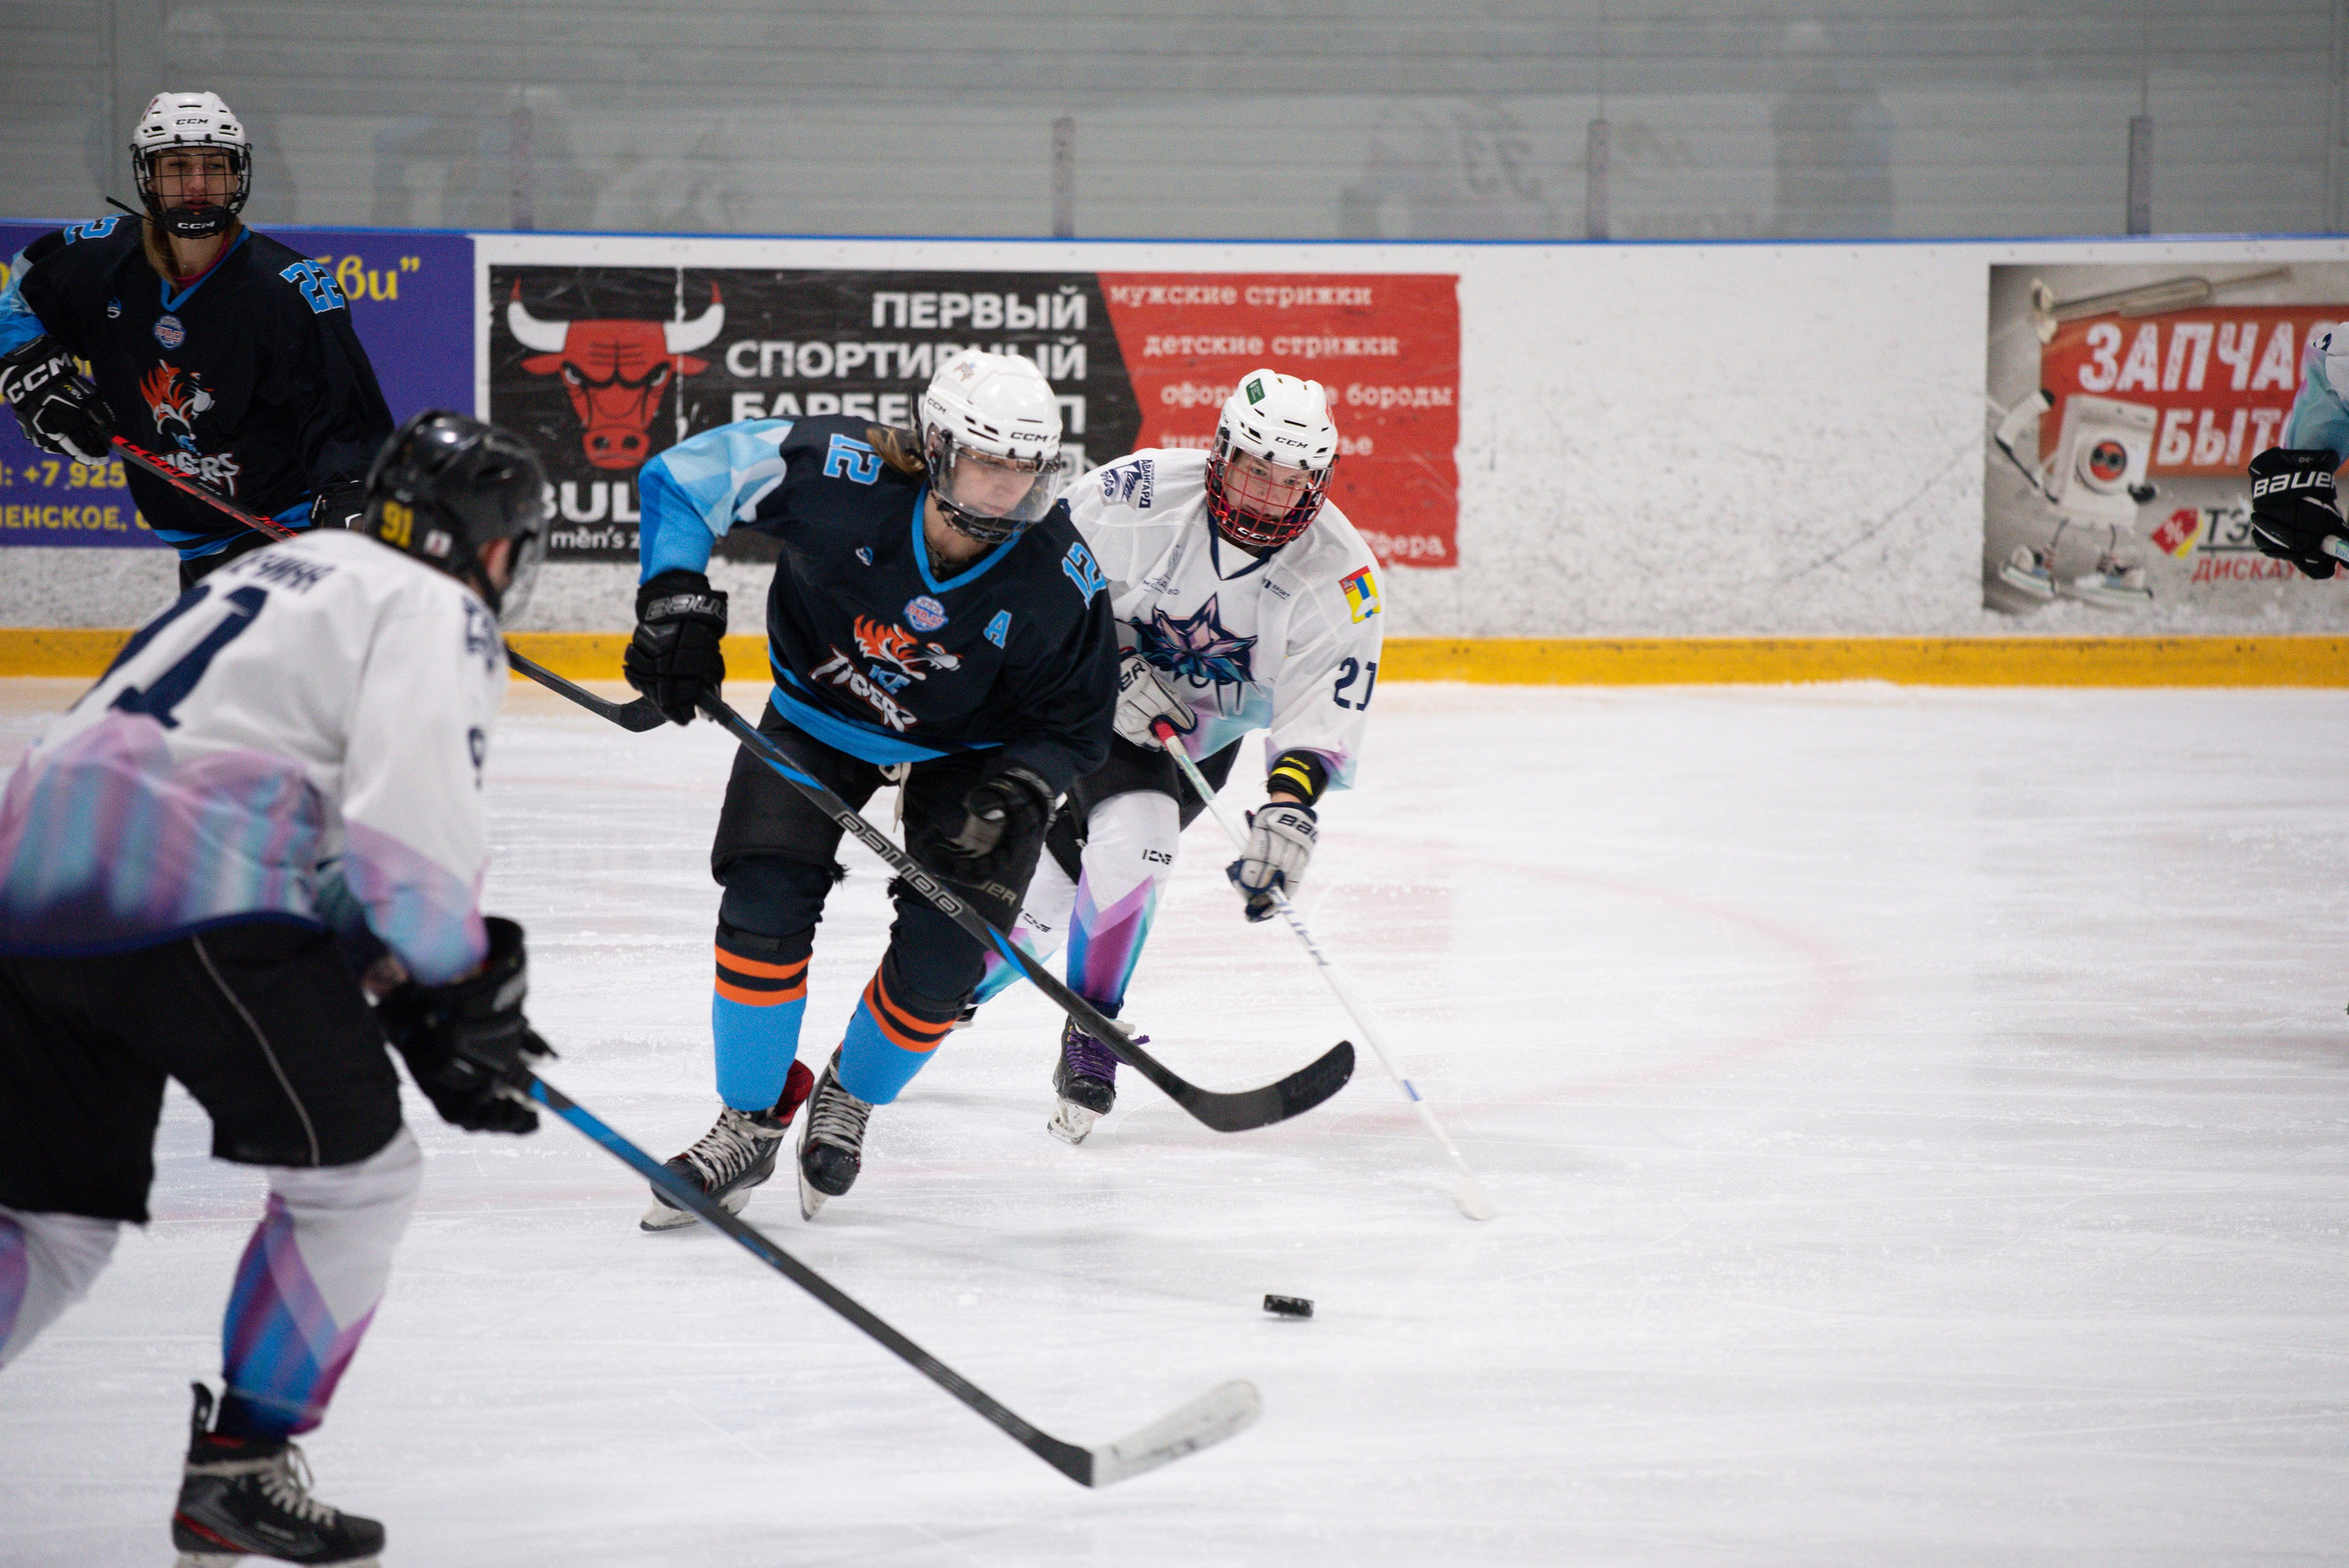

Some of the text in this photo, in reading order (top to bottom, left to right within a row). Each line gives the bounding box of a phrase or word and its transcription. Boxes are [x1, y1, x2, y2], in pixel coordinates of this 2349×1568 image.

[177, 221, 216, 229] CCM
[279, 259, 346, 314] 22
[1109, 286, 1373, 308] мужские стрижки
[872, 285, 1087, 330] ПЕРВЫЙ
[1143, 335, 1399, 359] детские стрижки
[6, 352, 73, 405] CCM
[927, 397, 947, 414] CCM
[1345, 382, 1453, 409] бороды
[1010, 431, 1049, 442] CCM
[1275, 436, 1308, 449] CCM
[823, 433, 884, 485] 12
[23, 461, 61, 488] +7
[69, 461, 128, 489] 925
[0, 506, 128, 532] ЕНСКОЕ,
[381, 499, 414, 550] 91
[1062, 541, 1107, 610] 12
[983, 609, 1012, 650] A
